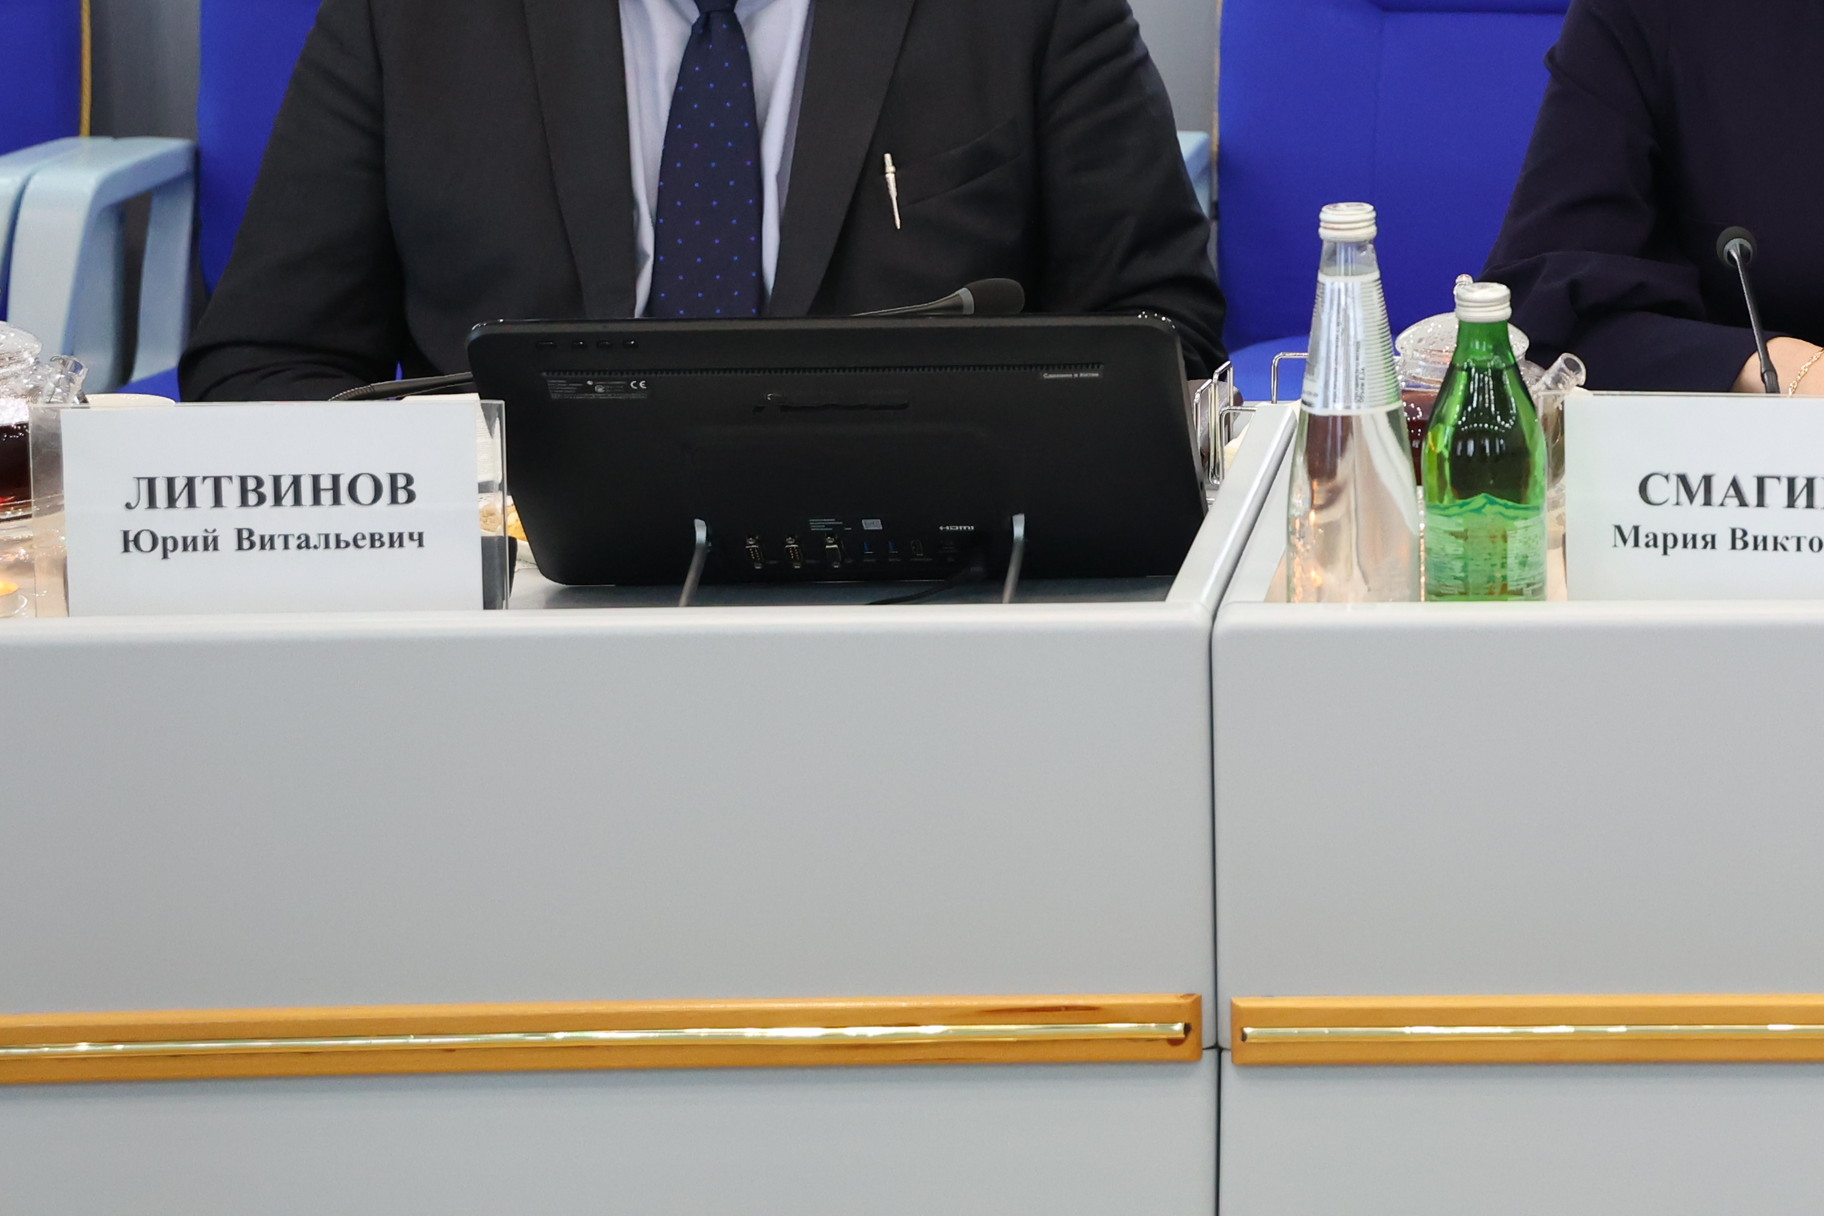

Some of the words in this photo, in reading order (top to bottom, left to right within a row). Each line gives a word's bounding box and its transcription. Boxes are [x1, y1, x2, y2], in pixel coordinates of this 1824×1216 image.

[125, 472, 417, 510] ЛИТВИНОВ
[121, 528, 220, 560] Юрий
[234, 527, 425, 552] Витальевич
[1612, 524, 1717, 556] Мария
